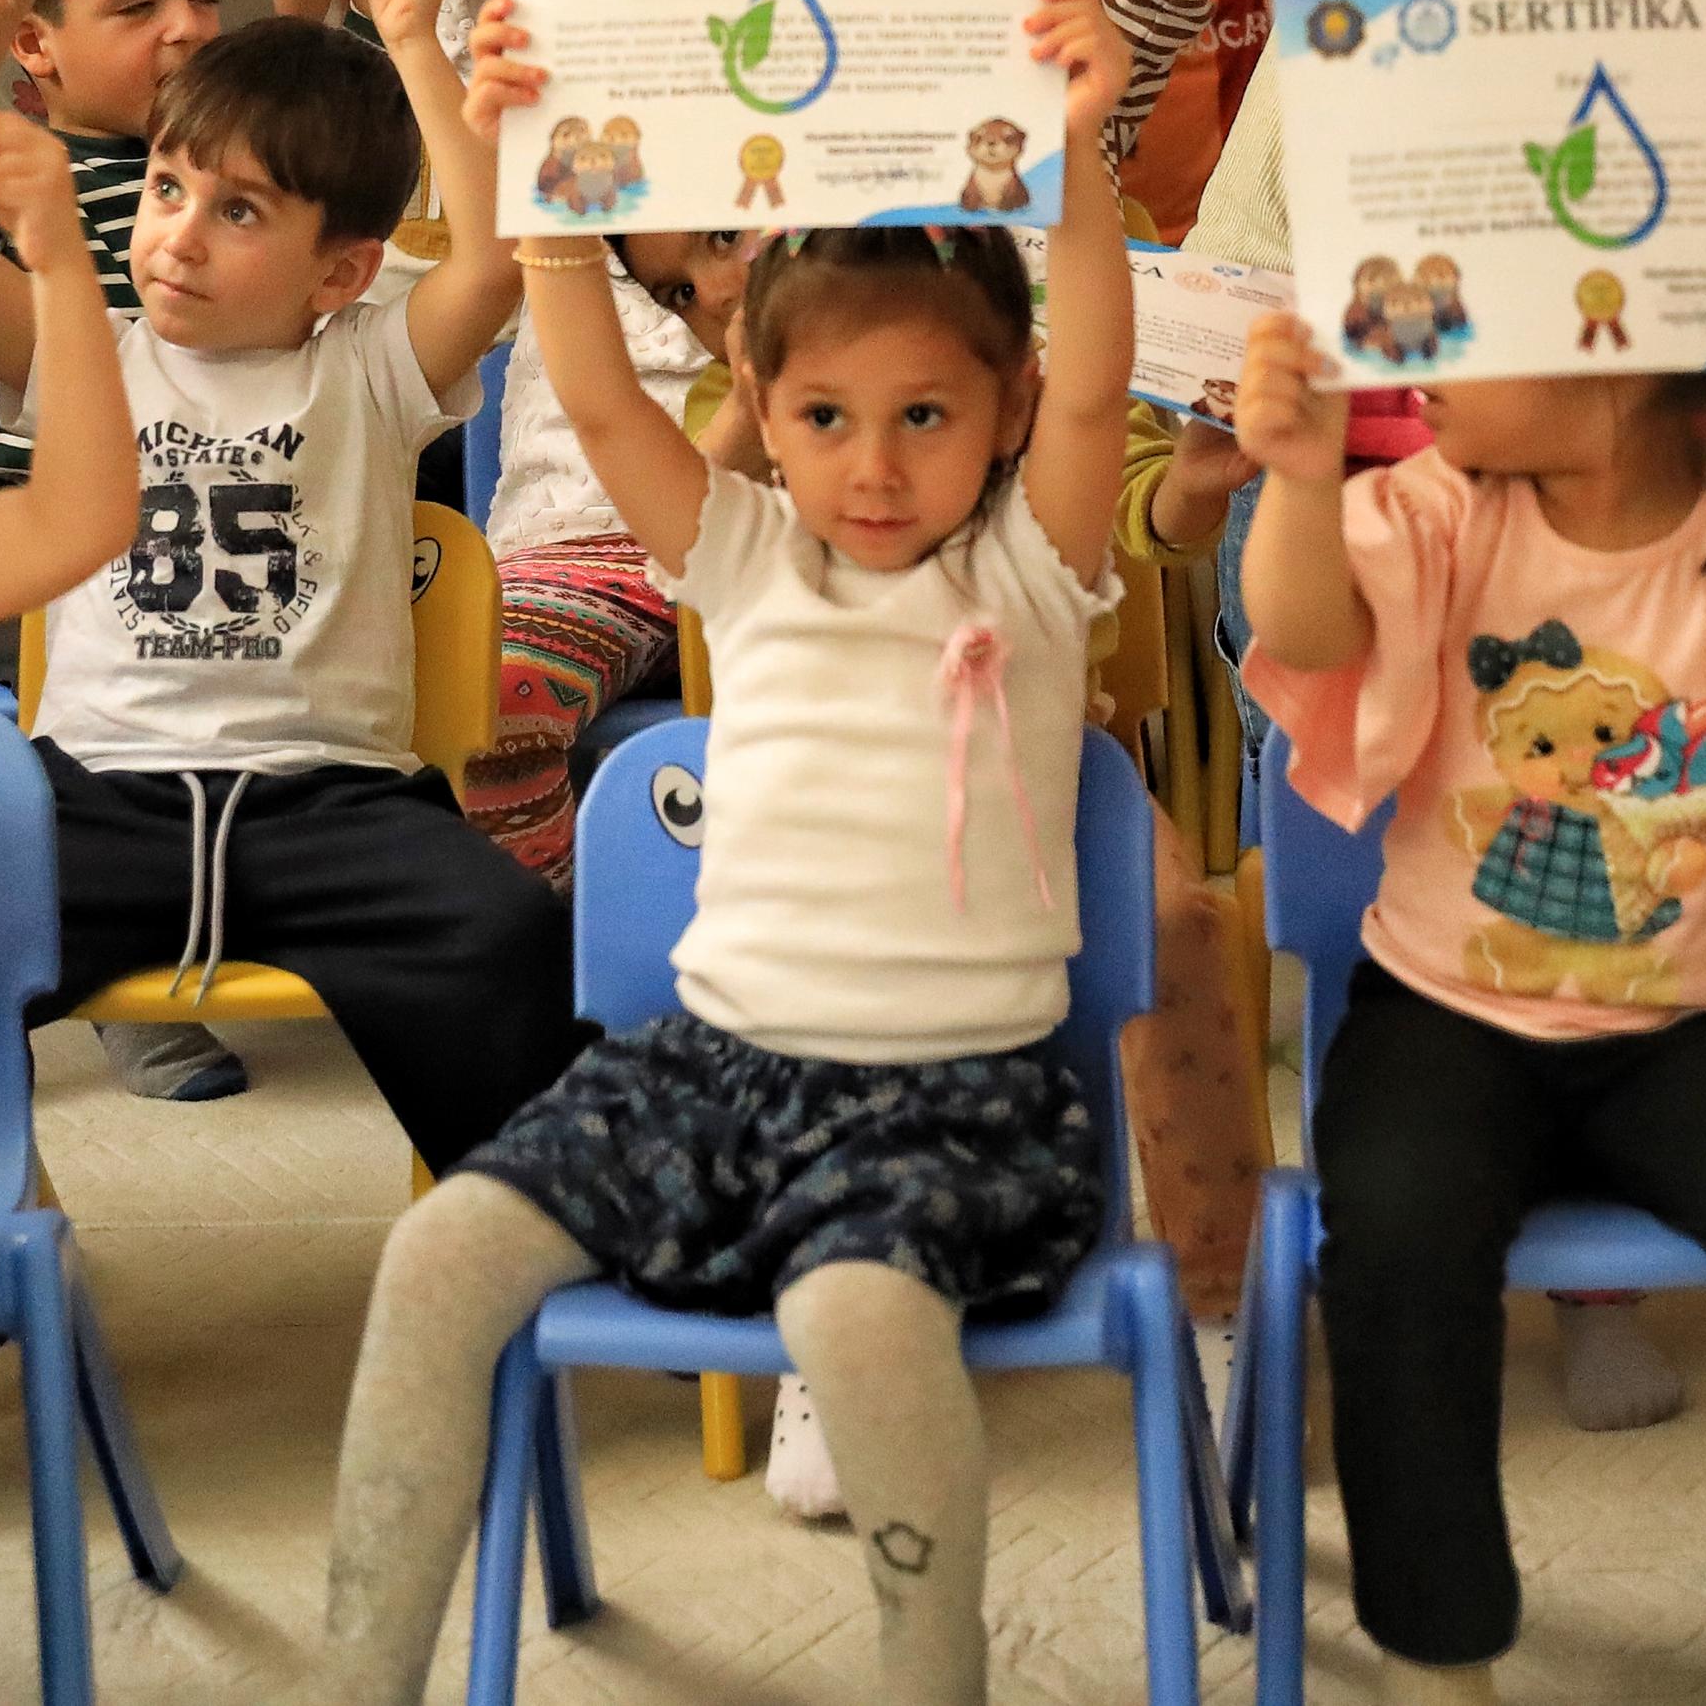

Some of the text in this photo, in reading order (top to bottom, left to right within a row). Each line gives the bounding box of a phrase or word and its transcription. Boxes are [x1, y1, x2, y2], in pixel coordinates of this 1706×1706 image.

[166, 447, 246, 467] STATE
[126, 482, 298, 613] 85
[133, 632, 282, 660] TEAM-PRO
